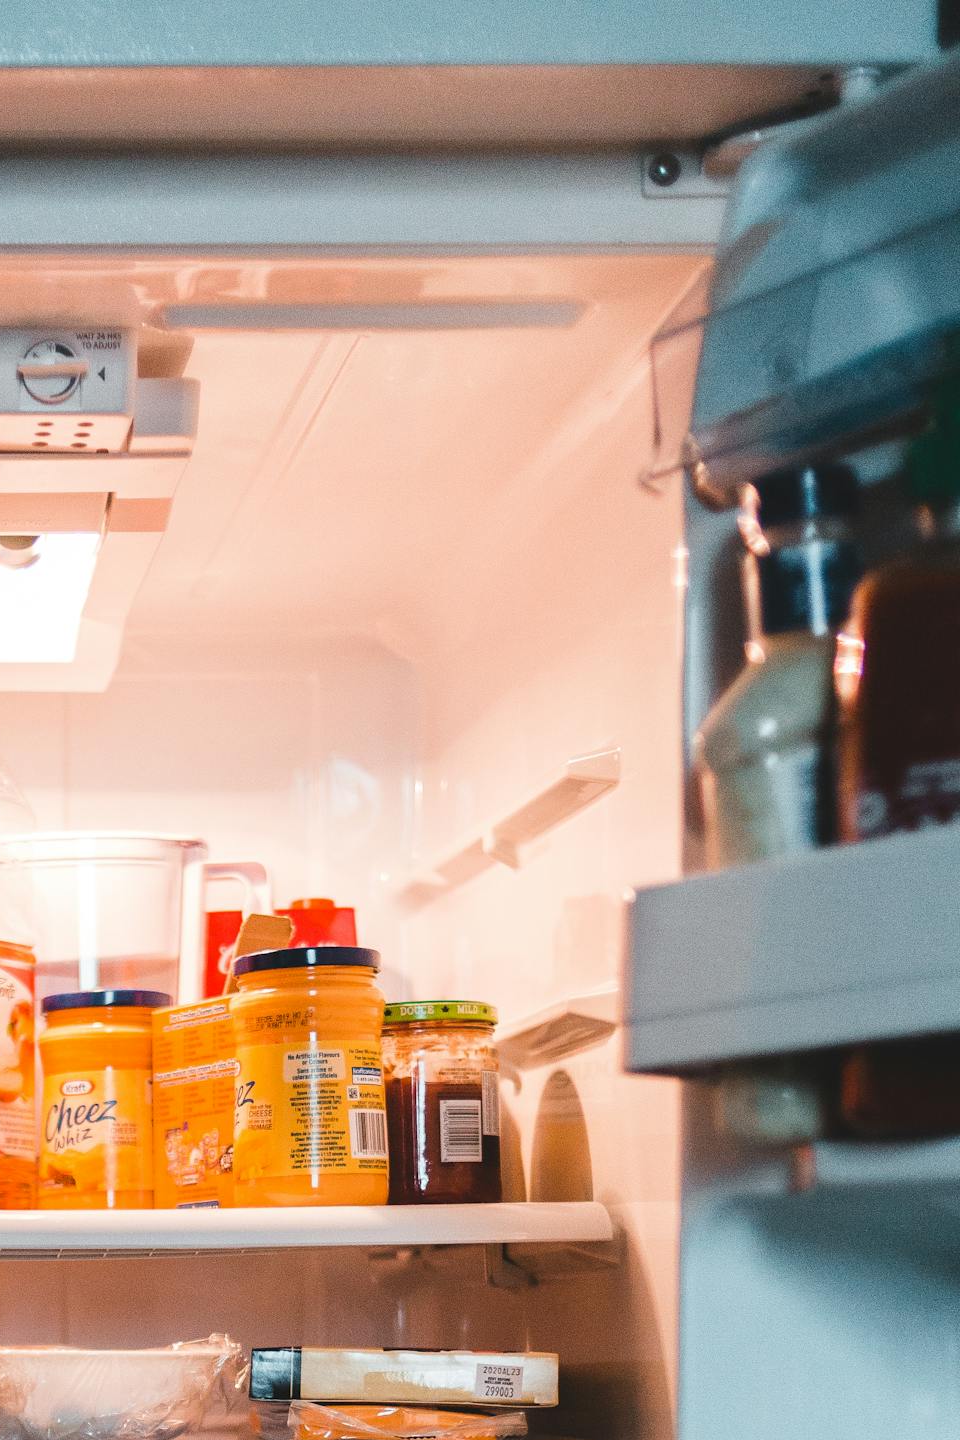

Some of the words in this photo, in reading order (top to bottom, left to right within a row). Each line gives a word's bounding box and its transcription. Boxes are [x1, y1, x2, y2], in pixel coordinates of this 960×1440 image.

[76, 332, 94, 340] WAIT
[82, 341, 92, 349] TO
[94, 341, 121, 350] ADJUST
[399, 1005, 435, 1016] DOUCE
[457, 1005, 480, 1015] MILD
[65, 1083, 87, 1093] Kraft
[46, 1098, 118, 1143] Cheez
[485, 1385, 514, 1398] 299003
